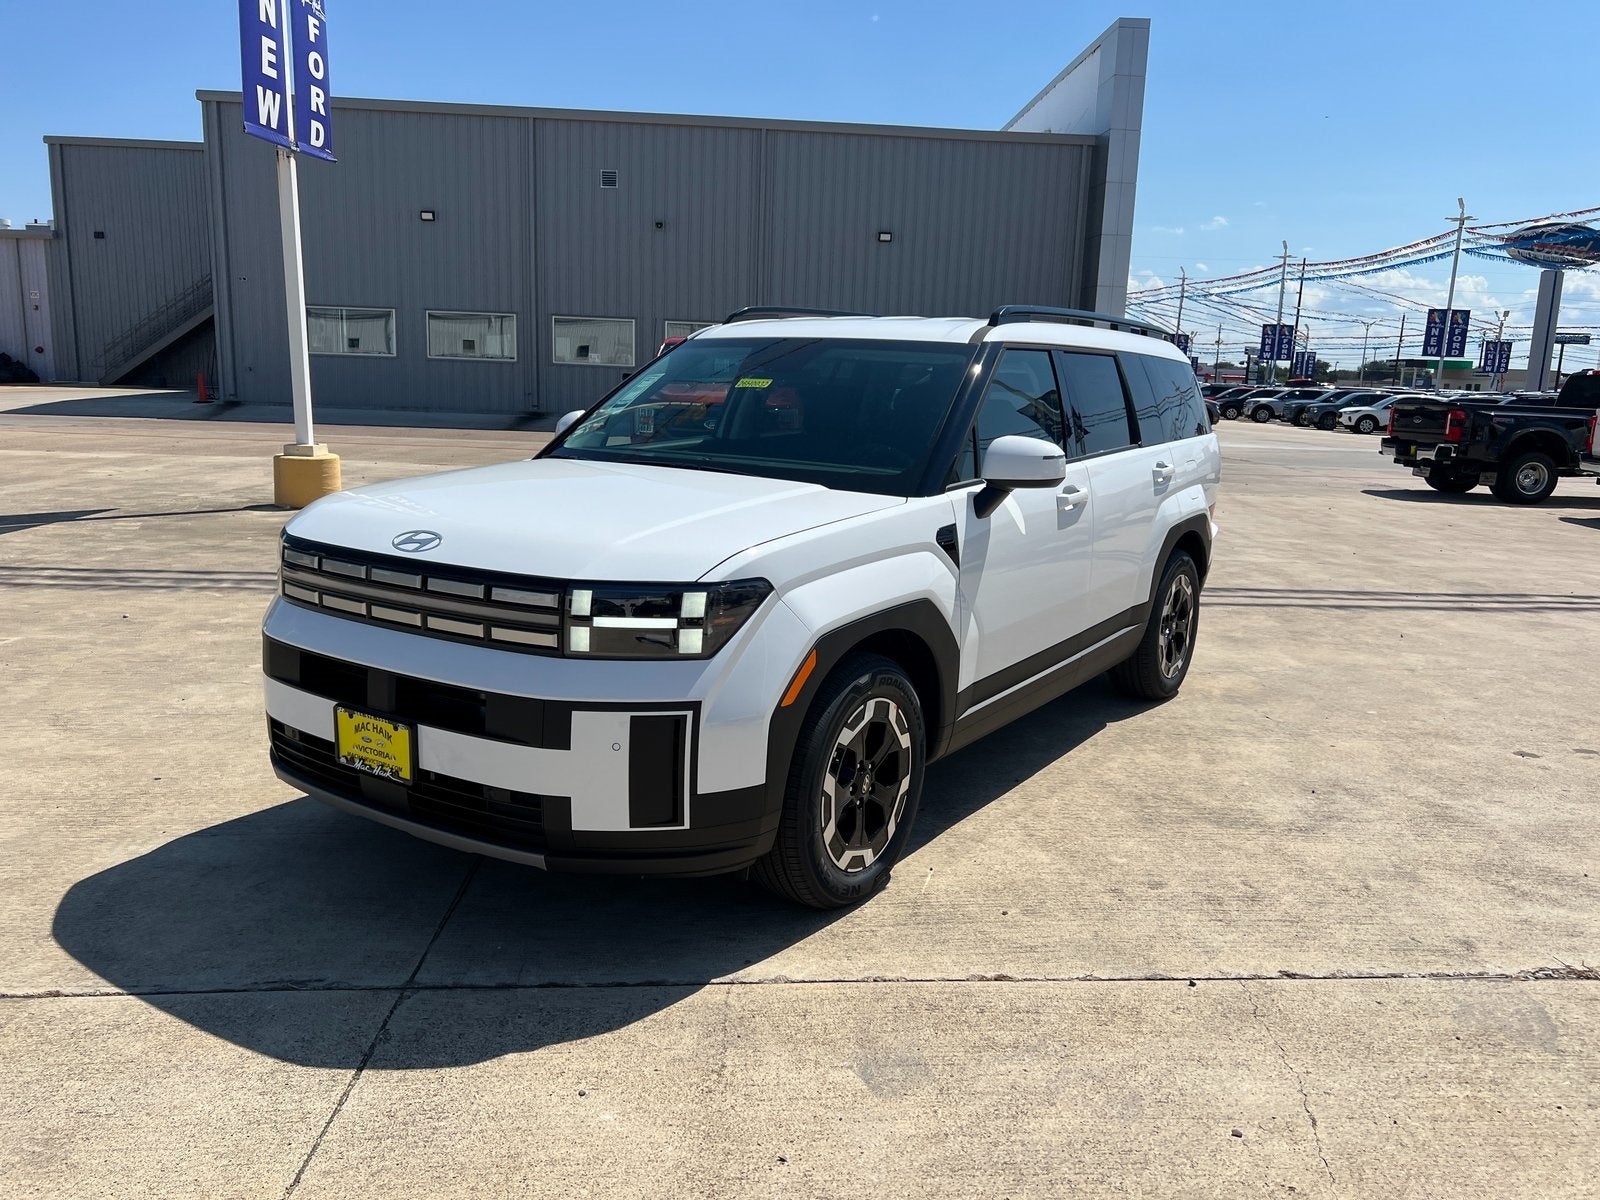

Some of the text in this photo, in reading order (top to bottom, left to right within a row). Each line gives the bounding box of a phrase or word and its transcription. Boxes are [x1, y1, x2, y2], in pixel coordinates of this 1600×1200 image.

[256, 0, 281, 130] NEW
[307, 14, 326, 148] FORD
[1263, 338, 1272, 359] NEW
[1281, 338, 1289, 360] FORD
[1427, 327, 1440, 355] NEW
[1451, 328, 1462, 356] FORD
[1485, 353, 1494, 372] NEW
[353, 722, 393, 745] MAC HAIK
[359, 745, 391, 760] VICTORIA
[353, 759, 373, 773] Mac
